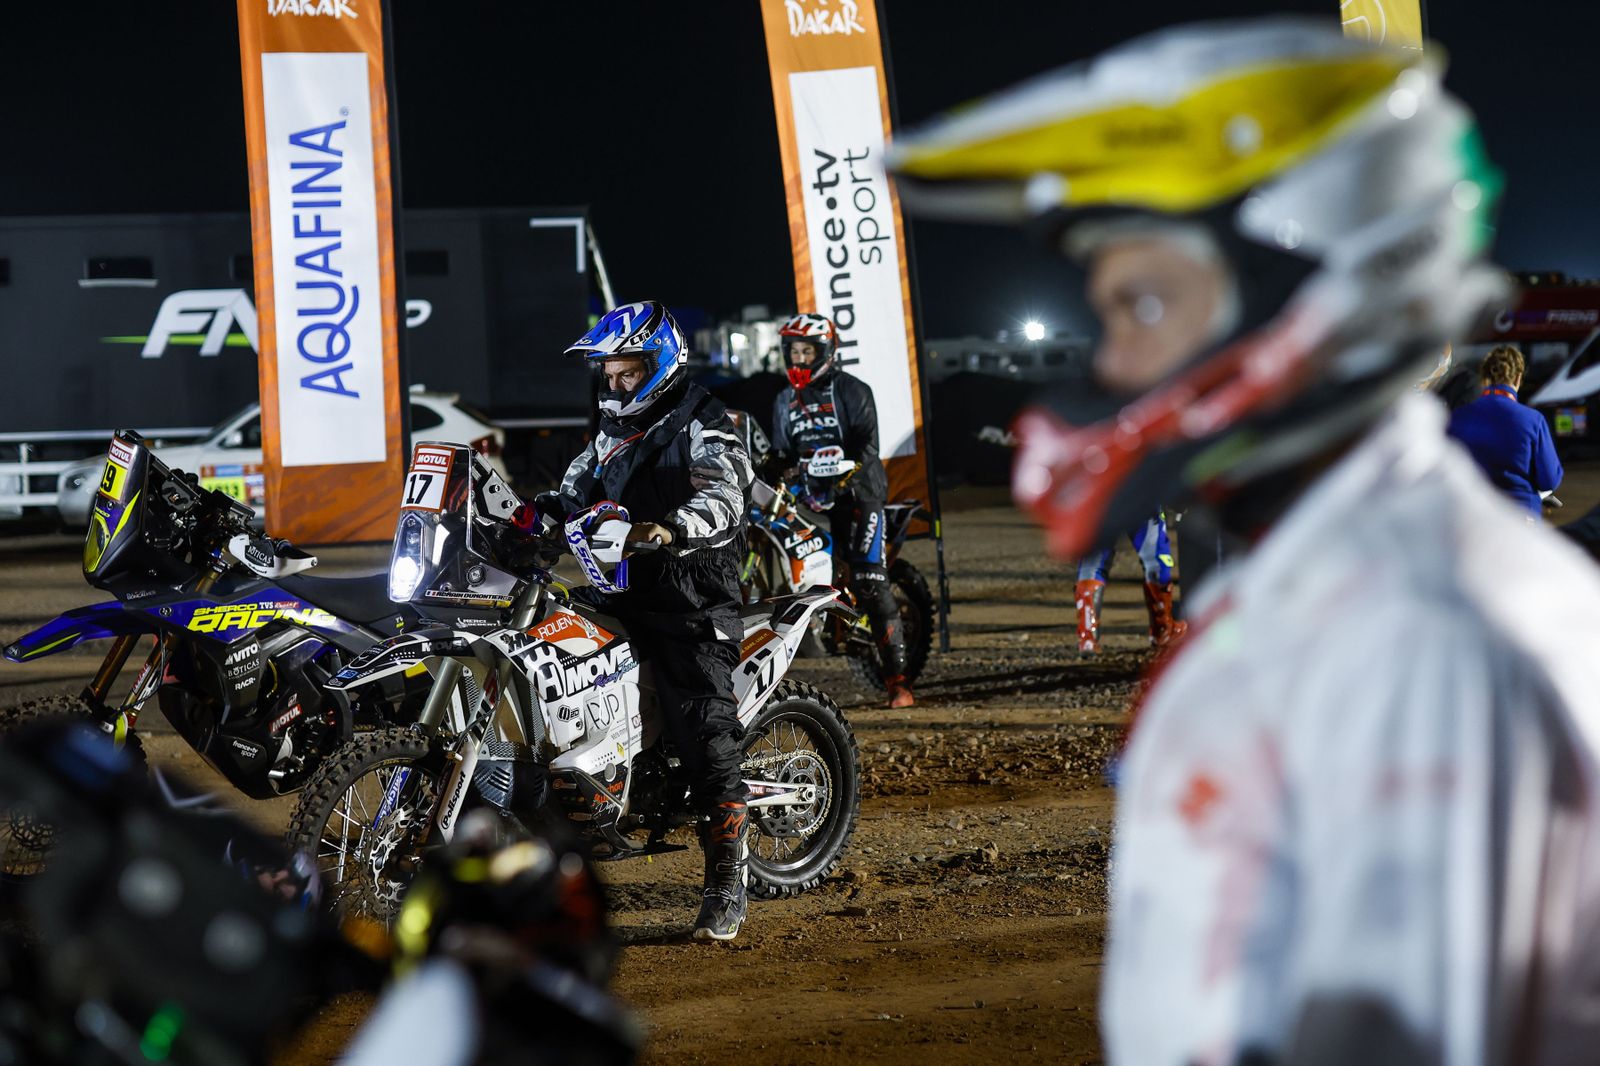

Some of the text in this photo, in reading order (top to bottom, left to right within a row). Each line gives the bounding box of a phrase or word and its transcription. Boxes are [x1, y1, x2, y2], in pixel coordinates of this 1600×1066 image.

[783, 0, 866, 37] DAKAR
[843, 146, 890, 265] sport
[111, 445, 130, 462] MOTUL
[416, 454, 447, 465] MOTUL
[406, 474, 434, 505] 17
[795, 536, 824, 560] SHAD
[855, 572, 886, 582] SHAD
[193, 603, 258, 616] SHERCO
[259, 601, 274, 610] TVS
[537, 614, 574, 640] ROUEN
[564, 640, 635, 698] MOVE
[743, 647, 776, 701] 17
[271, 705, 301, 732] MOTUL
[441, 770, 467, 830] Polisport
